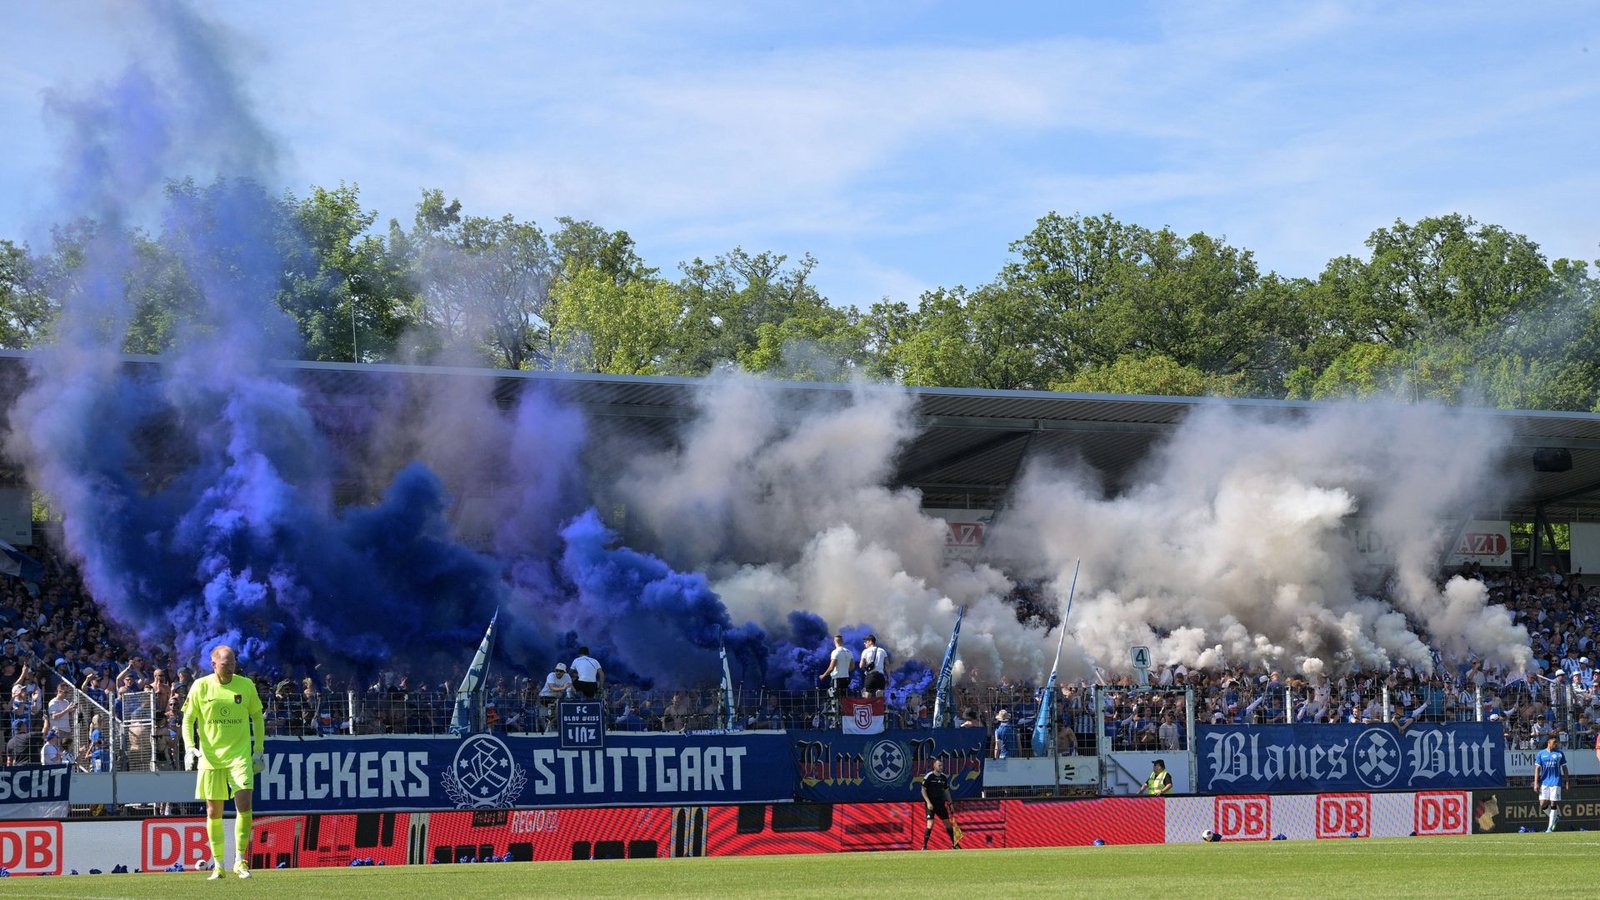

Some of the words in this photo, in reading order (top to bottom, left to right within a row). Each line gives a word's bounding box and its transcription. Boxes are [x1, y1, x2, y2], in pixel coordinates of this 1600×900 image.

[1456, 533, 1499, 553] AZI
[1136, 649, 1146, 665] 4
[576, 705, 587, 714] FC
[568, 726, 596, 743] LINZ
[260, 751, 430, 800] KICKERS
[533, 747, 747, 794] STUTTGART
[796, 740, 866, 790] Blue
[1205, 731, 1349, 790] Blaues
[1405, 729, 1496, 786] Blut
[512, 810, 545, 833] REGIO
[1221, 802, 1264, 835] DB
[1323, 800, 1364, 833] DB
[1421, 798, 1461, 831] DB
[1505, 804, 1572, 818] FINALG
[152, 826, 212, 866] DB
